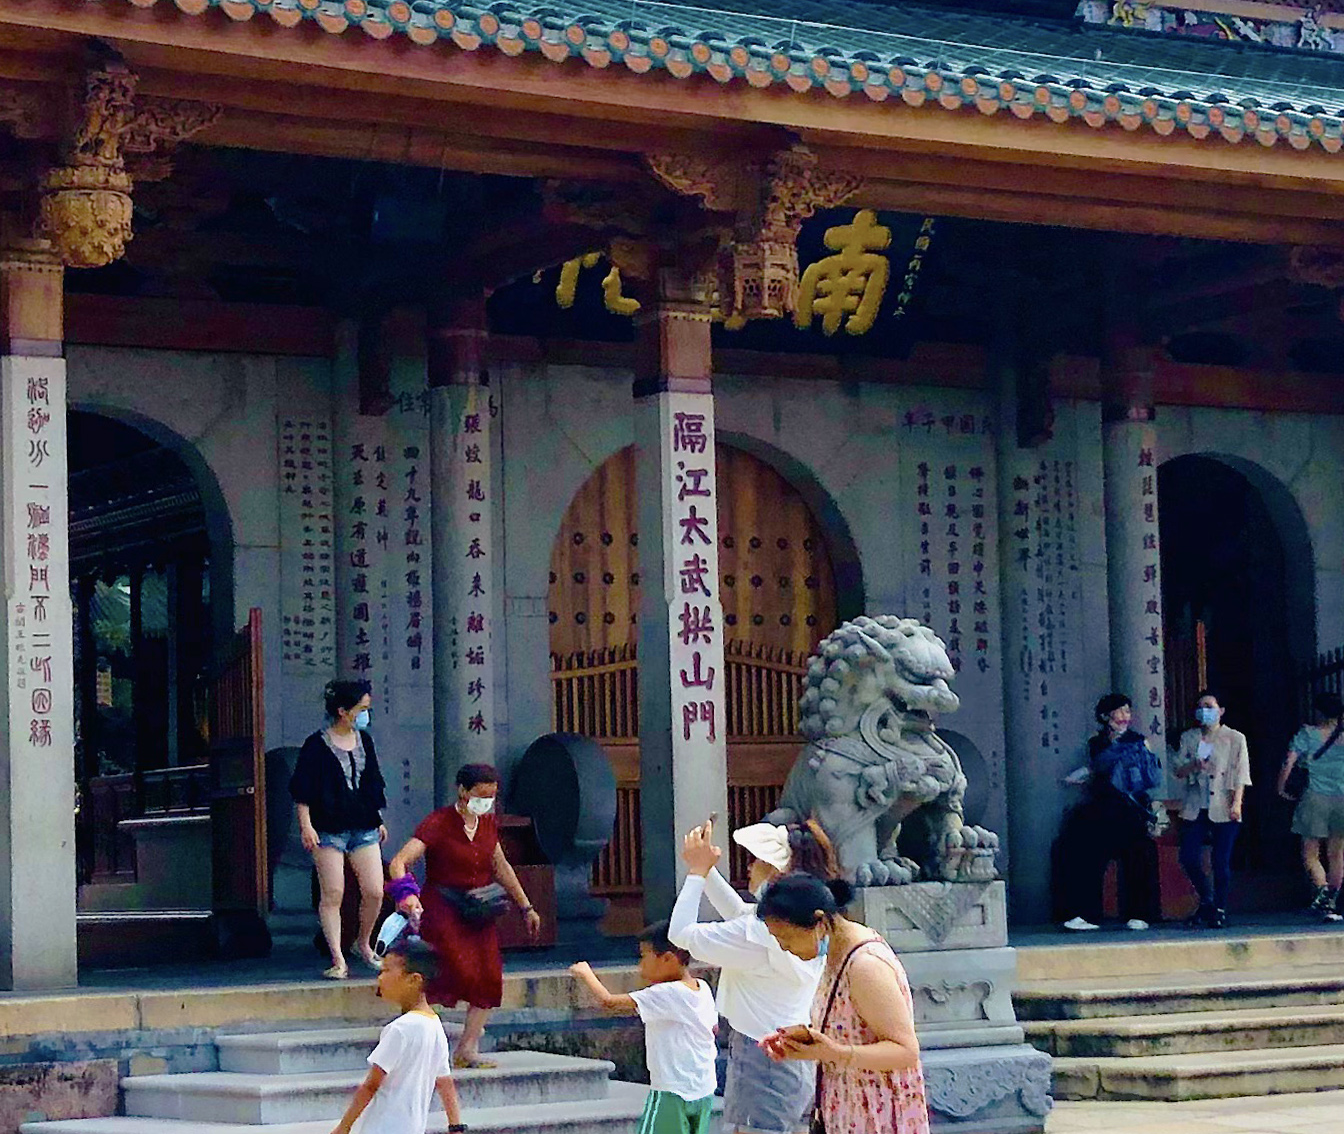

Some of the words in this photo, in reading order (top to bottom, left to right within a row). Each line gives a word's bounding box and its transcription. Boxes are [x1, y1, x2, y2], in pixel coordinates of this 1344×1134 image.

[671, 411, 719, 741] 隔江太武拱山門
